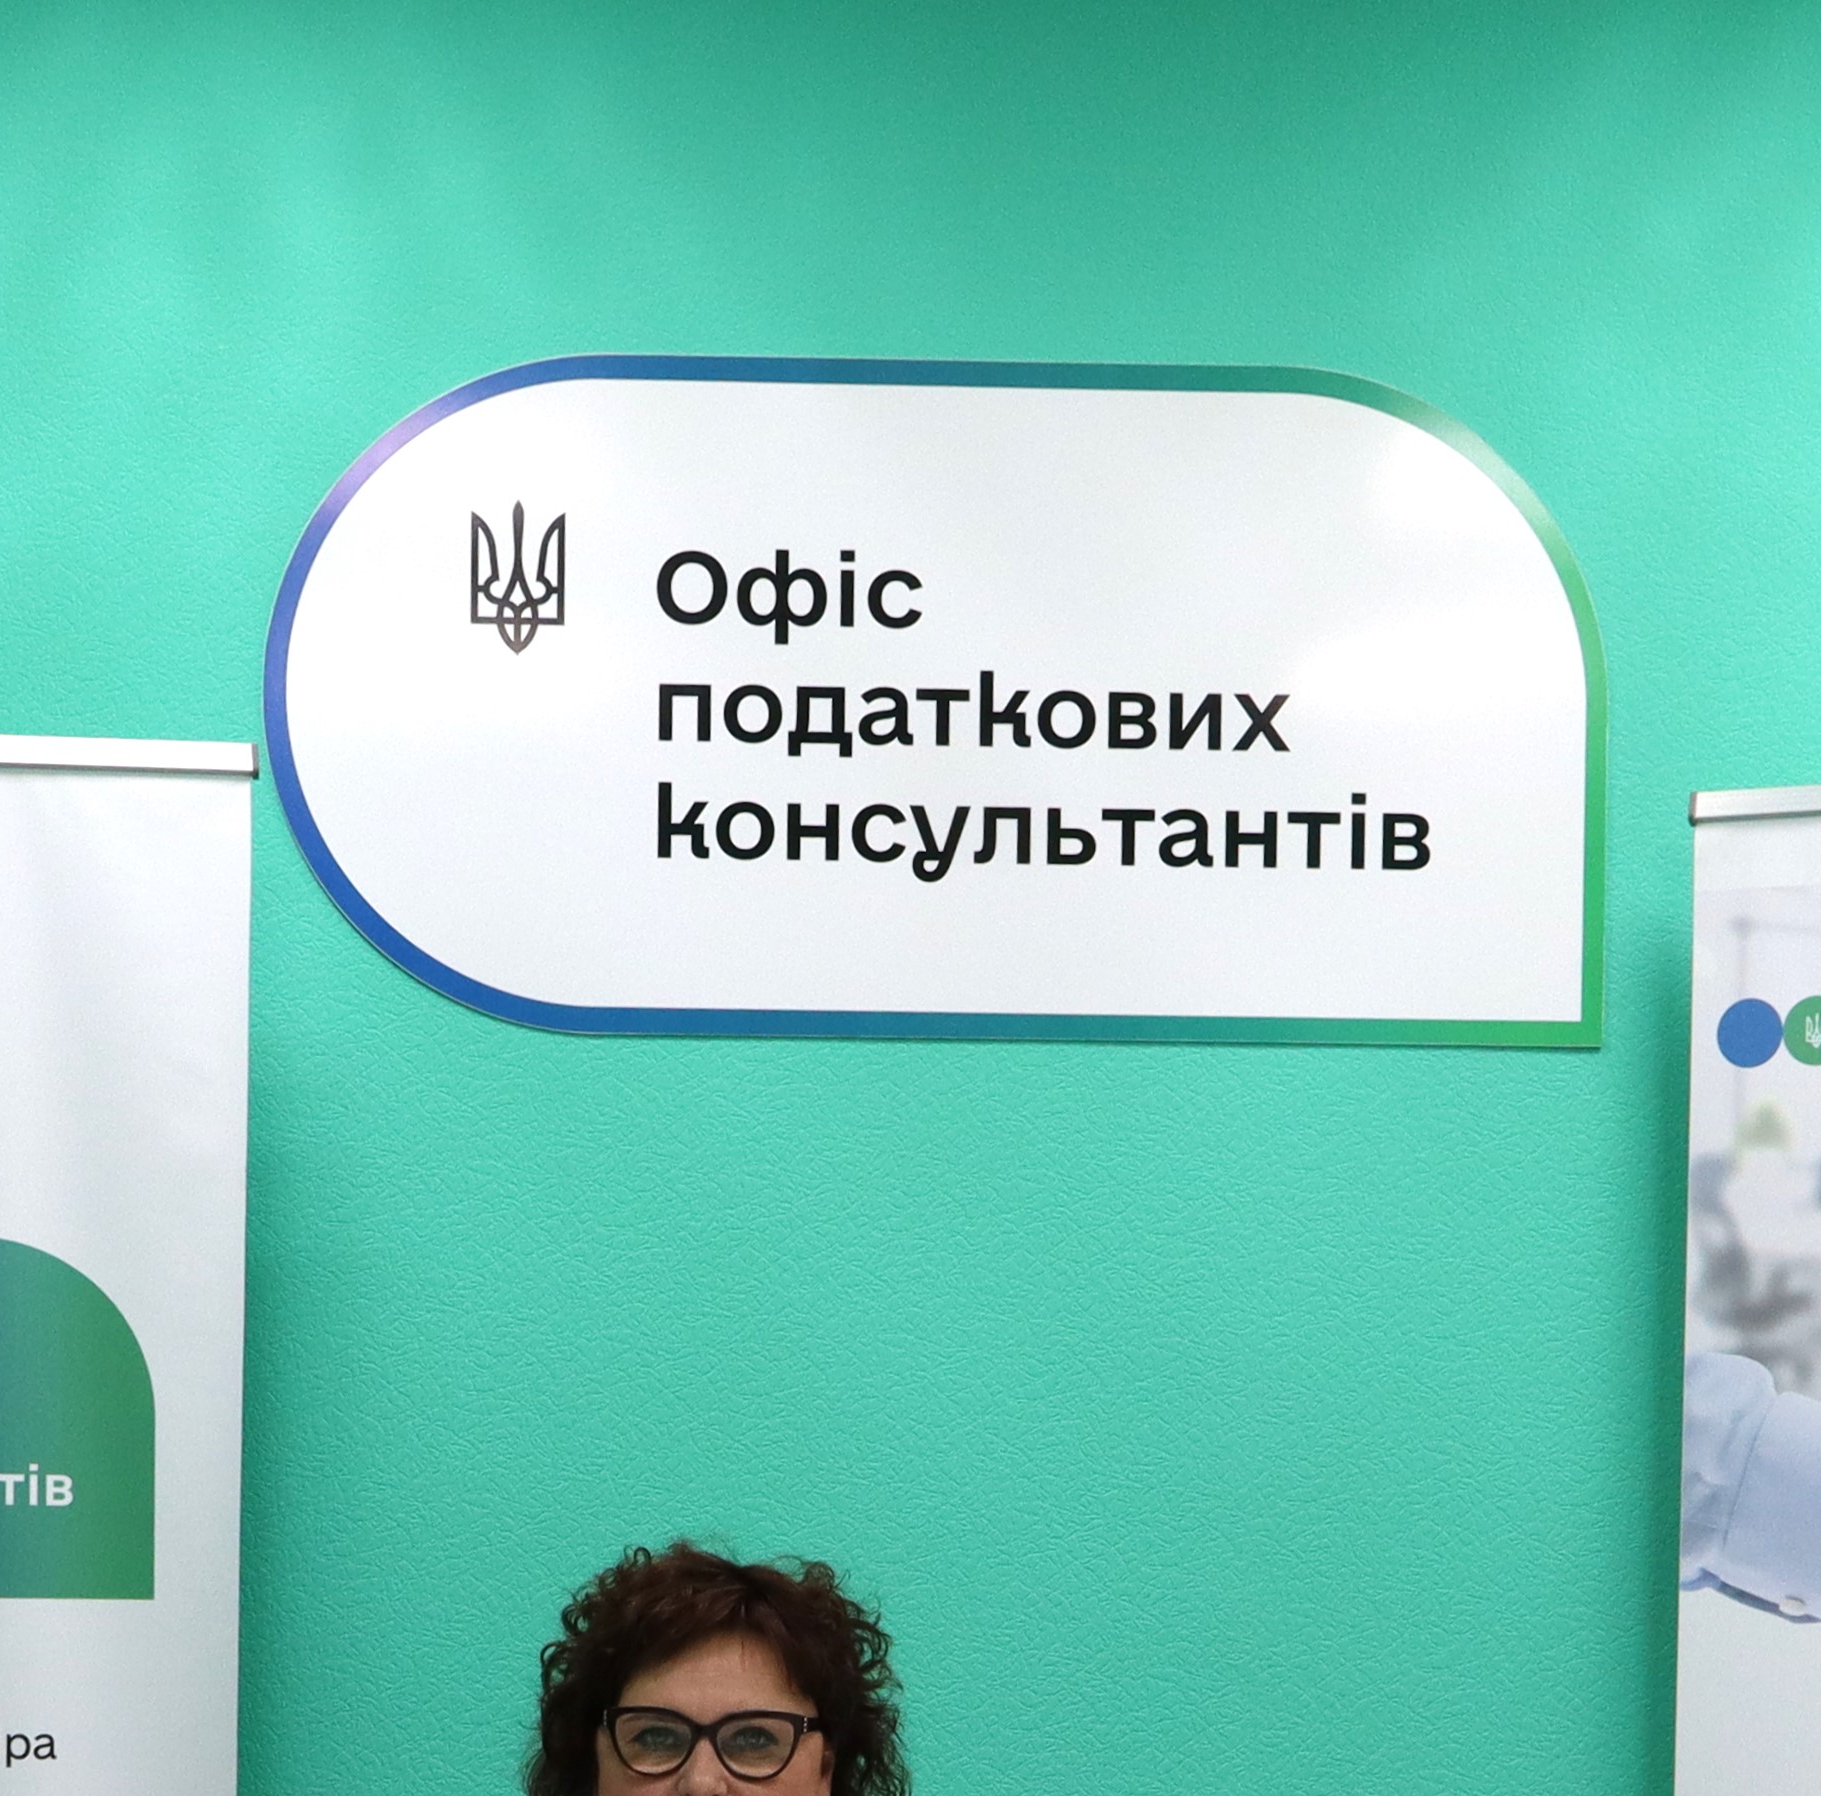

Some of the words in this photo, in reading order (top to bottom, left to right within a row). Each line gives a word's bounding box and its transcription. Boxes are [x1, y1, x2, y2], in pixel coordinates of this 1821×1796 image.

[655, 548, 924, 646] Офіс
[657, 669, 1291, 759] податкових
[656, 780, 1432, 884] консультантів
